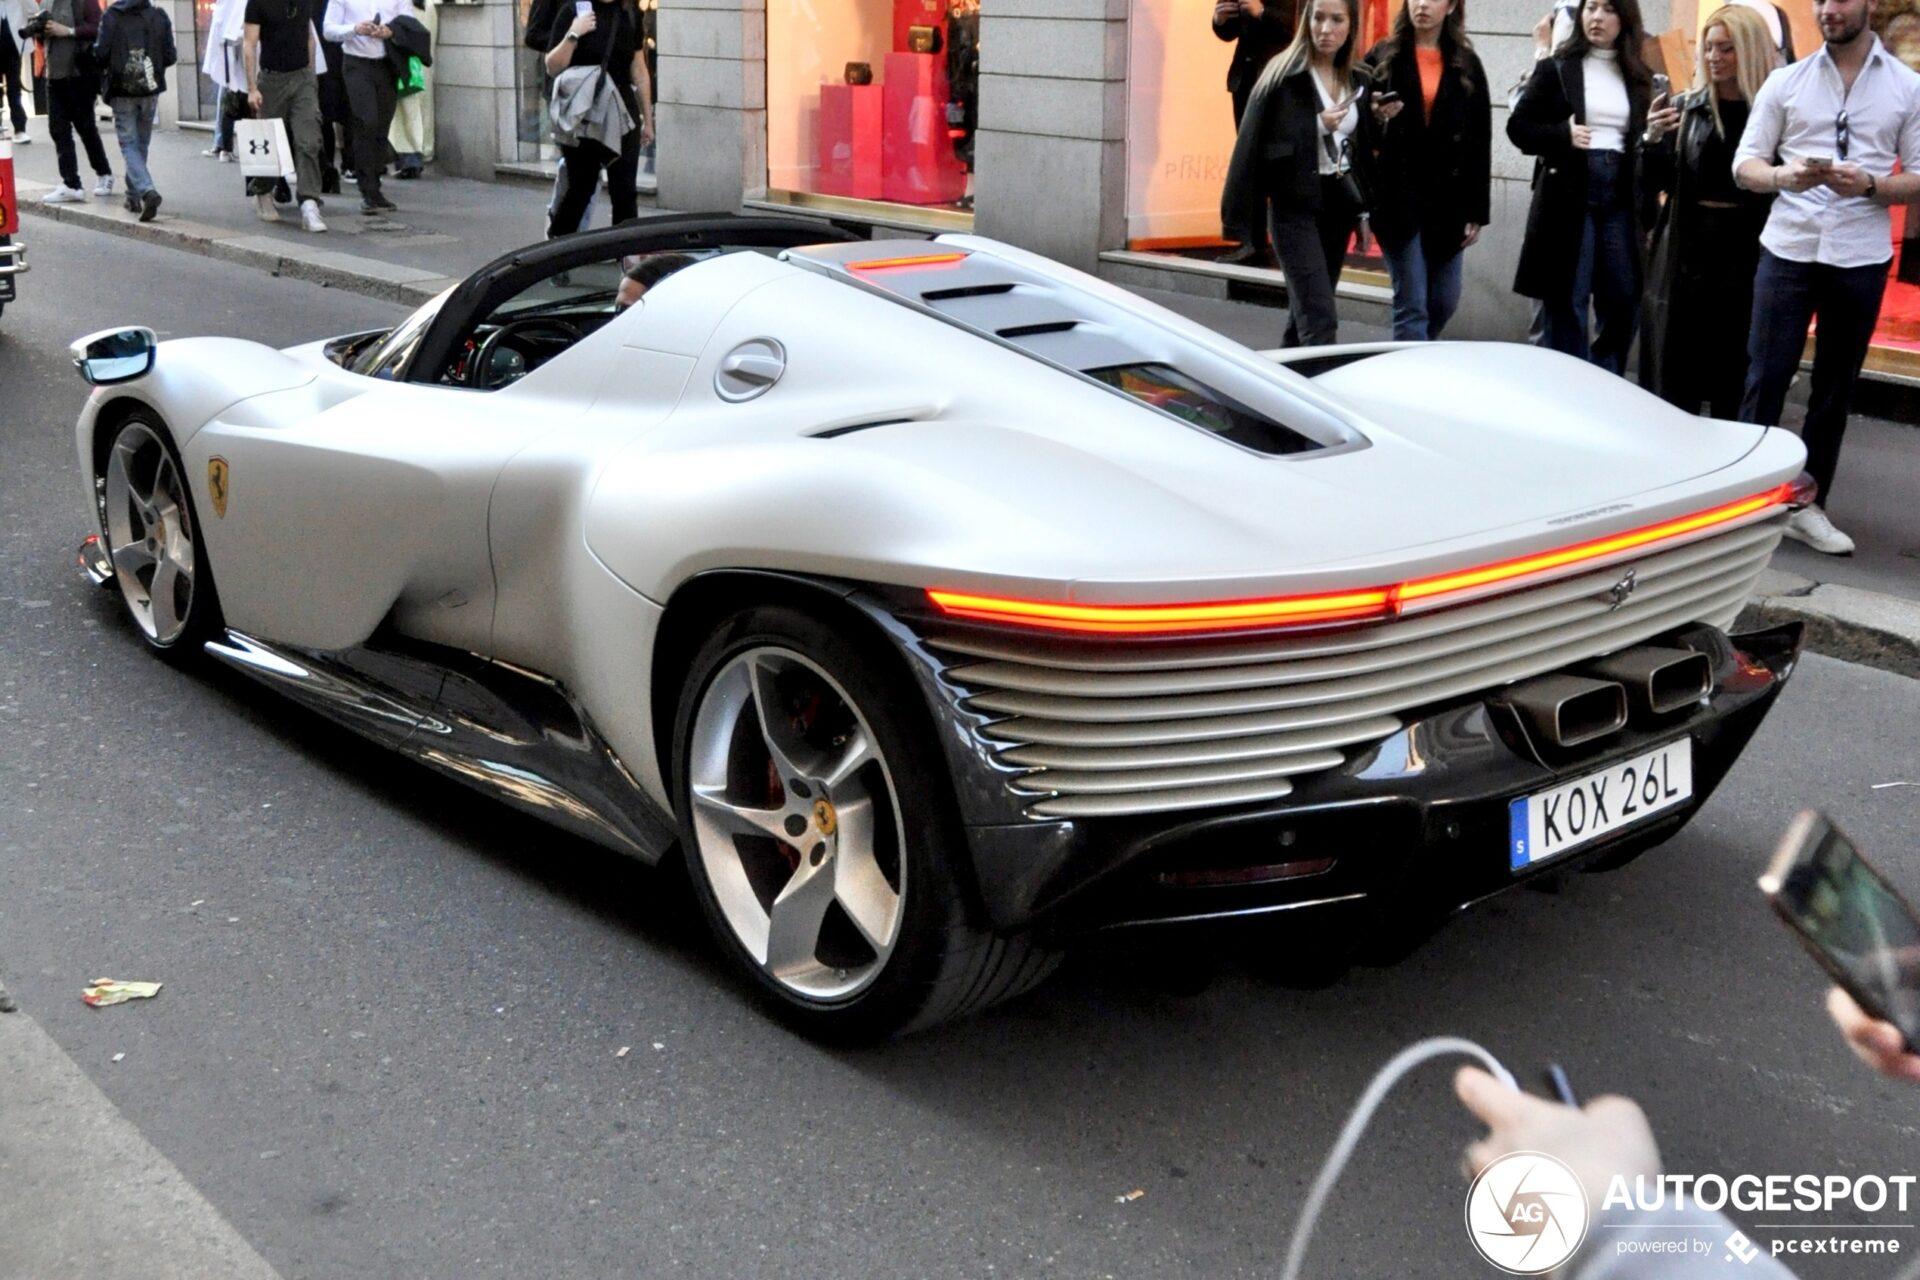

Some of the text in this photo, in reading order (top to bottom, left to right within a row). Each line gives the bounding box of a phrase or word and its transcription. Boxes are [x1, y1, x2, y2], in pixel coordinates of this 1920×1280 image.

[1544, 753, 1678, 847] KOX 26L
[1516, 840, 1524, 854] S
